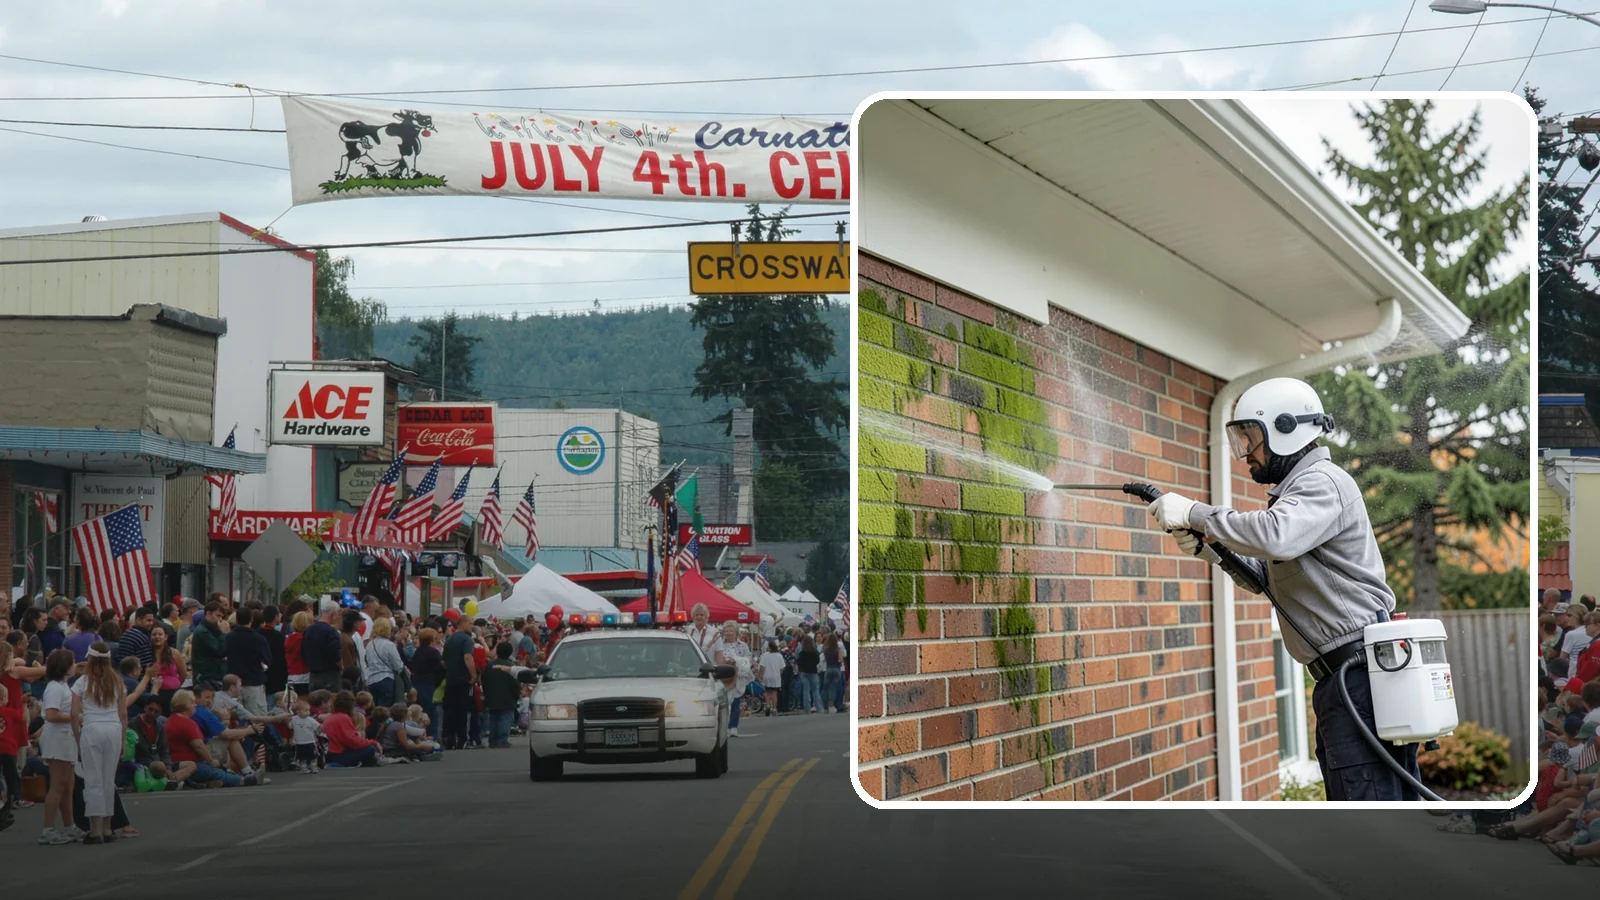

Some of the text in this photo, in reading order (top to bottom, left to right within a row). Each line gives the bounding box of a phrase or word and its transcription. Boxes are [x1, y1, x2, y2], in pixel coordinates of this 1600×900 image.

[481, 141, 604, 192] JULY
[632, 150, 746, 198] 4th.
[697, 254, 850, 280] CROSSWA
[282, 380, 373, 420] ACE
[406, 410, 452, 422] CEDAR
[283, 421, 371, 436] Hardware
[416, 428, 477, 447] Coca-Cola
[83, 484, 155, 496] St. Vincent de Paul
[688, 526, 741, 535] CRNATION
[699, 535, 730, 543] GLASS
